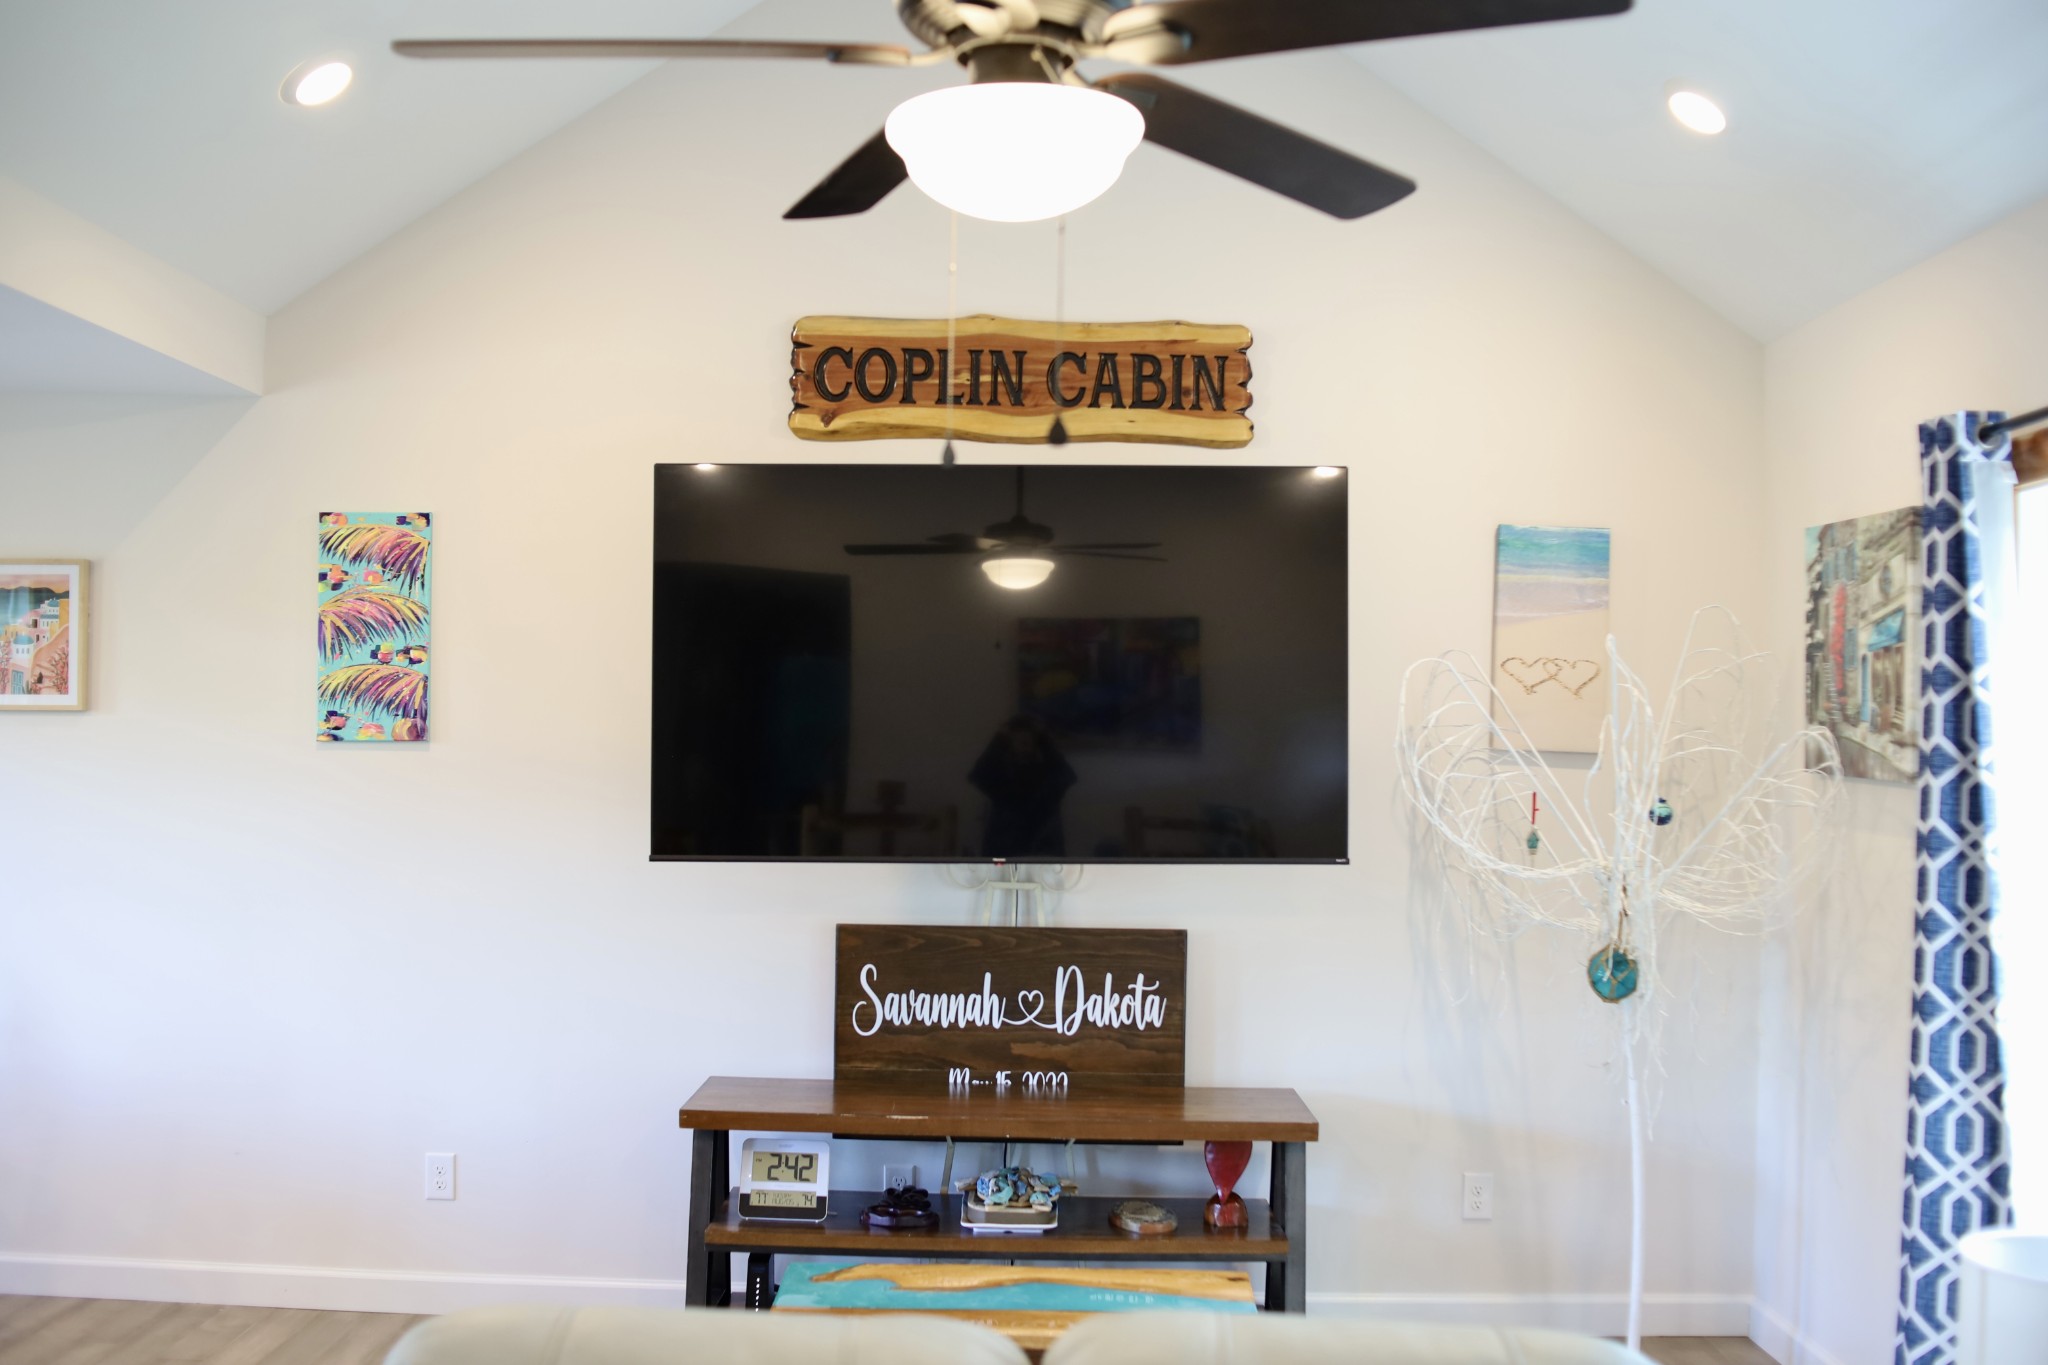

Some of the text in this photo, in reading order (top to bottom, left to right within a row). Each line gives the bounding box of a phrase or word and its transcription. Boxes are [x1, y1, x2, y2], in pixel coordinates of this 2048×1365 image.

[814, 346, 1229, 411] COPLIN CABIN
[852, 963, 1167, 1036] Savannah Dakota
[767, 1153, 814, 1182] 2:42
